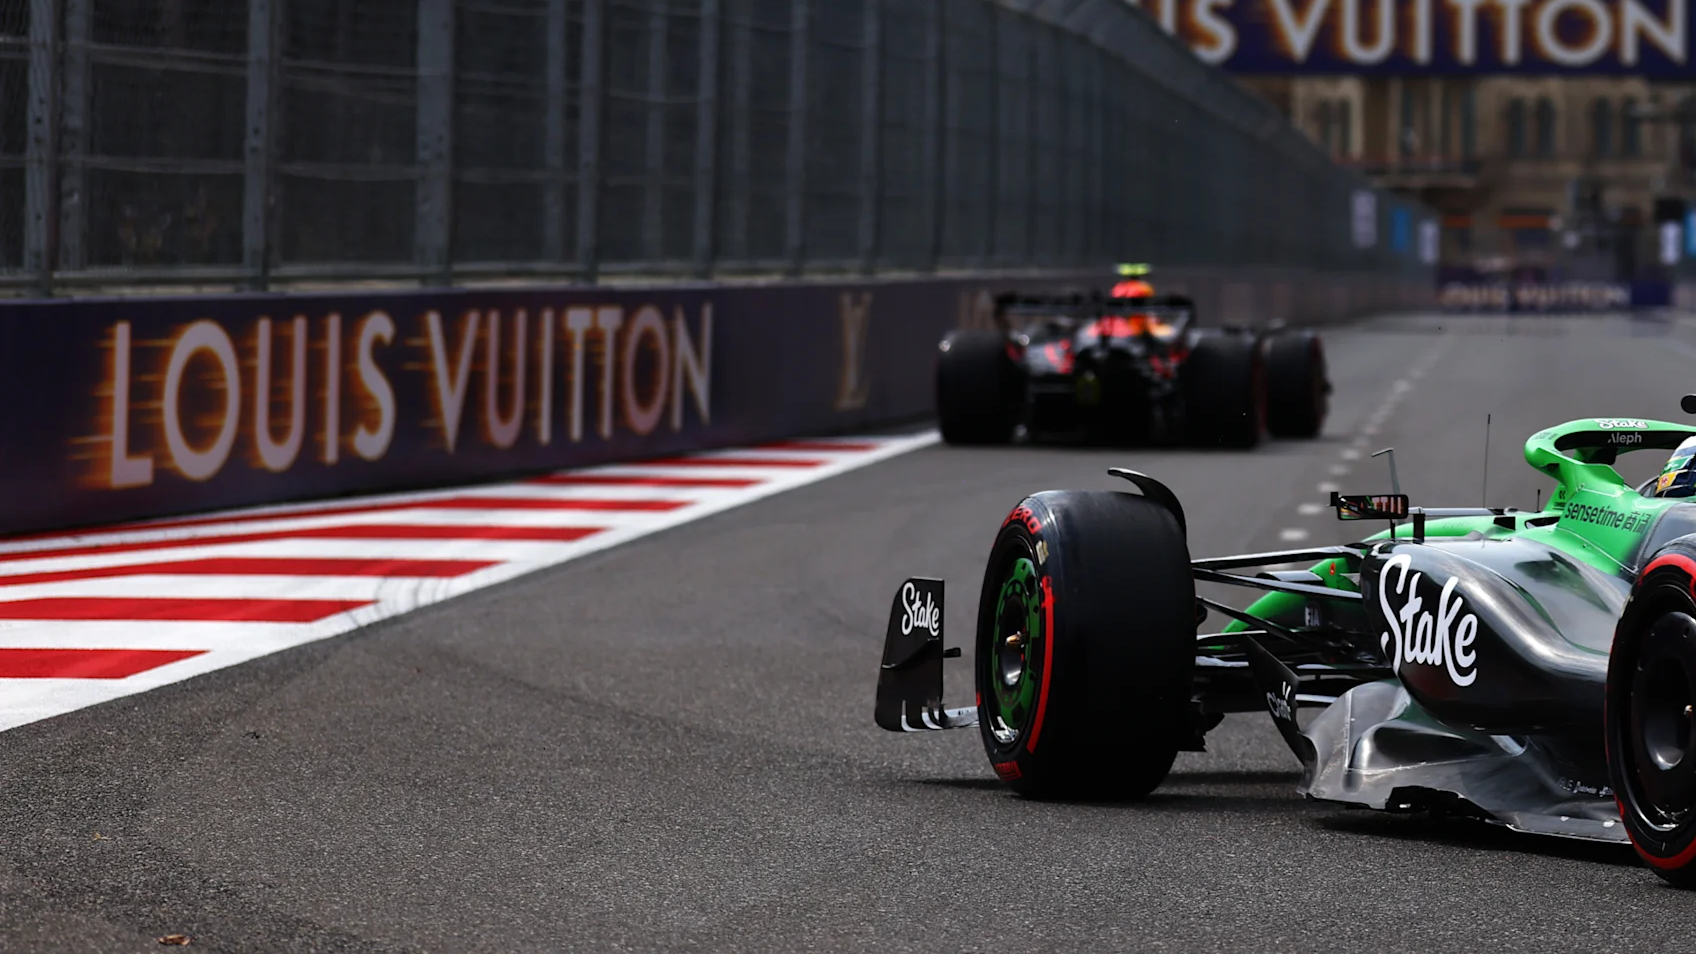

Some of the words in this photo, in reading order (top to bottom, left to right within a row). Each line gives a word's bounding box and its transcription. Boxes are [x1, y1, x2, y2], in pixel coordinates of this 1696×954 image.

[108, 309, 398, 489] LOUIS
[427, 301, 714, 453] VUITTON
[1594, 418, 1649, 429] Stake
[1564, 500, 1625, 530] sensetime
[901, 581, 940, 637] Stake
[1378, 553, 1479, 687] Stake
